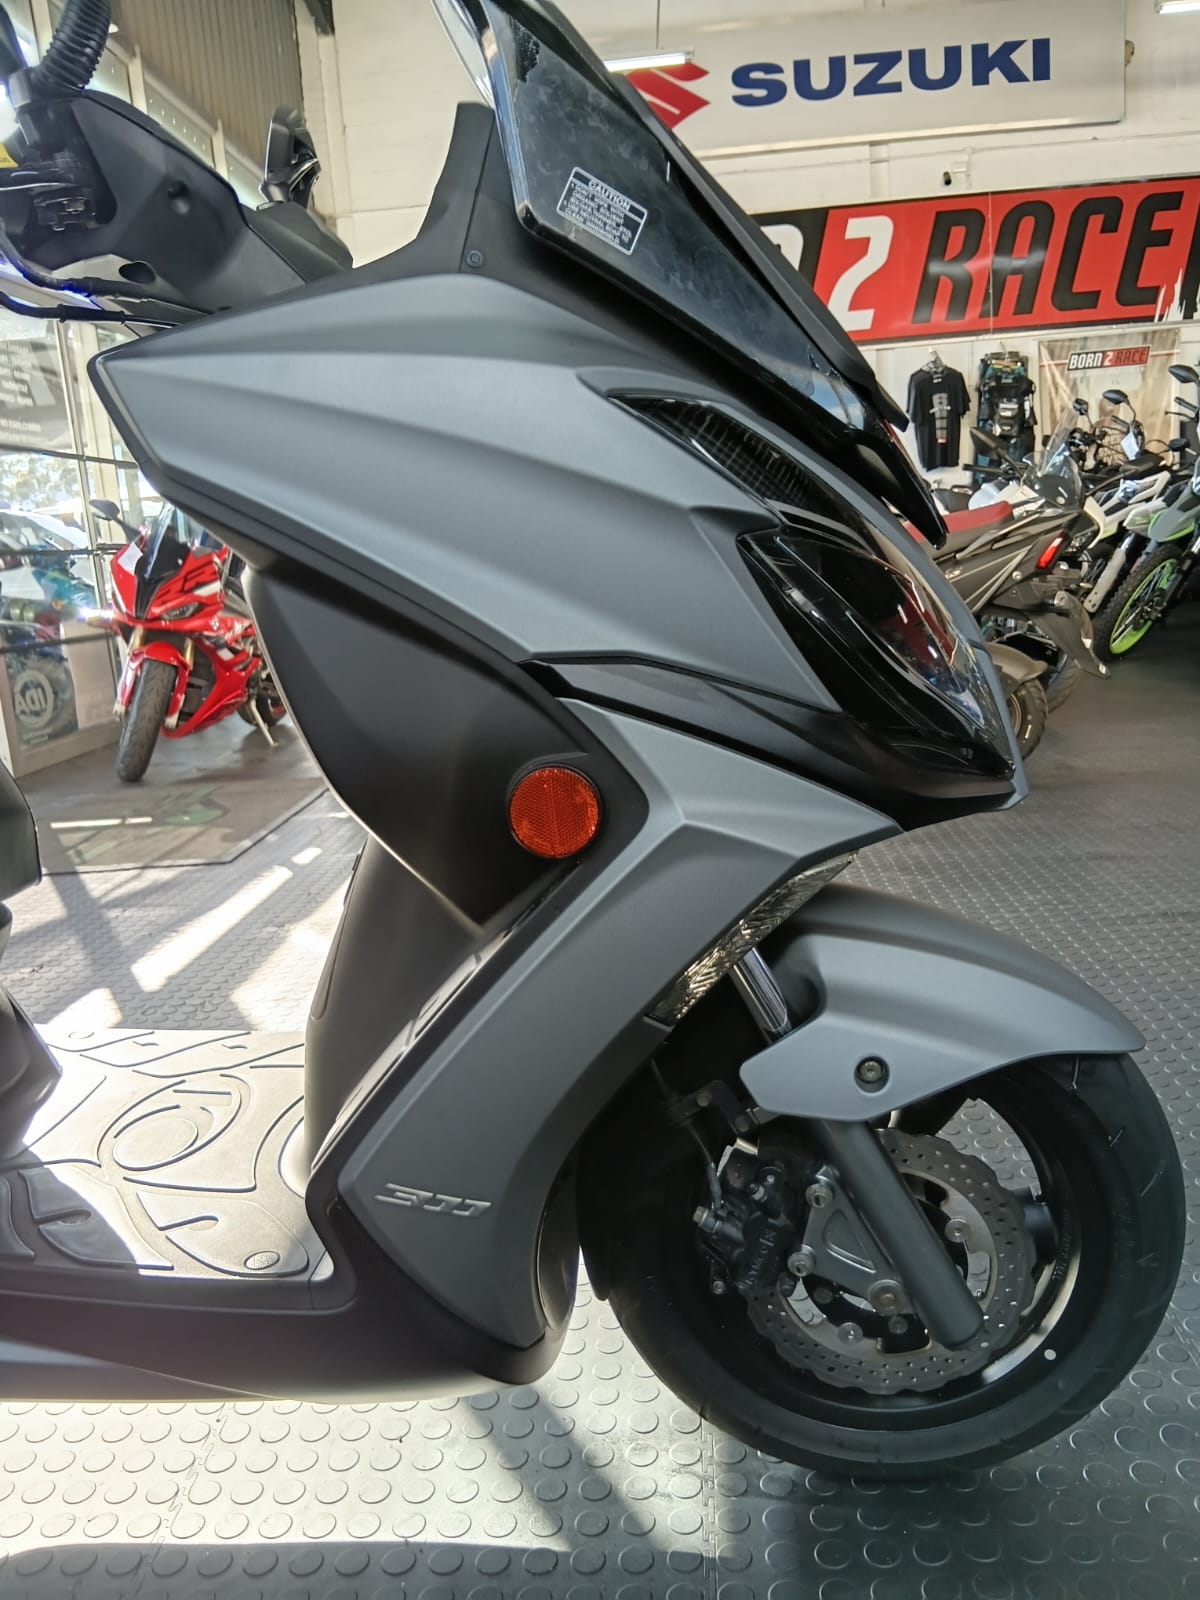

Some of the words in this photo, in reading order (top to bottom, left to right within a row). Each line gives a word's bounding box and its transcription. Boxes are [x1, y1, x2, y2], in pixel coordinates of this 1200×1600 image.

[731, 38, 1051, 107] SUZUKI
[587, 179, 630, 210] CAUTION
[826, 215, 894, 332] 2
[912, 191, 1185, 324] RACE
[1069, 352, 1103, 370] BORN
[1103, 351, 1114, 366] 2
[1115, 348, 1147, 365] RACE
